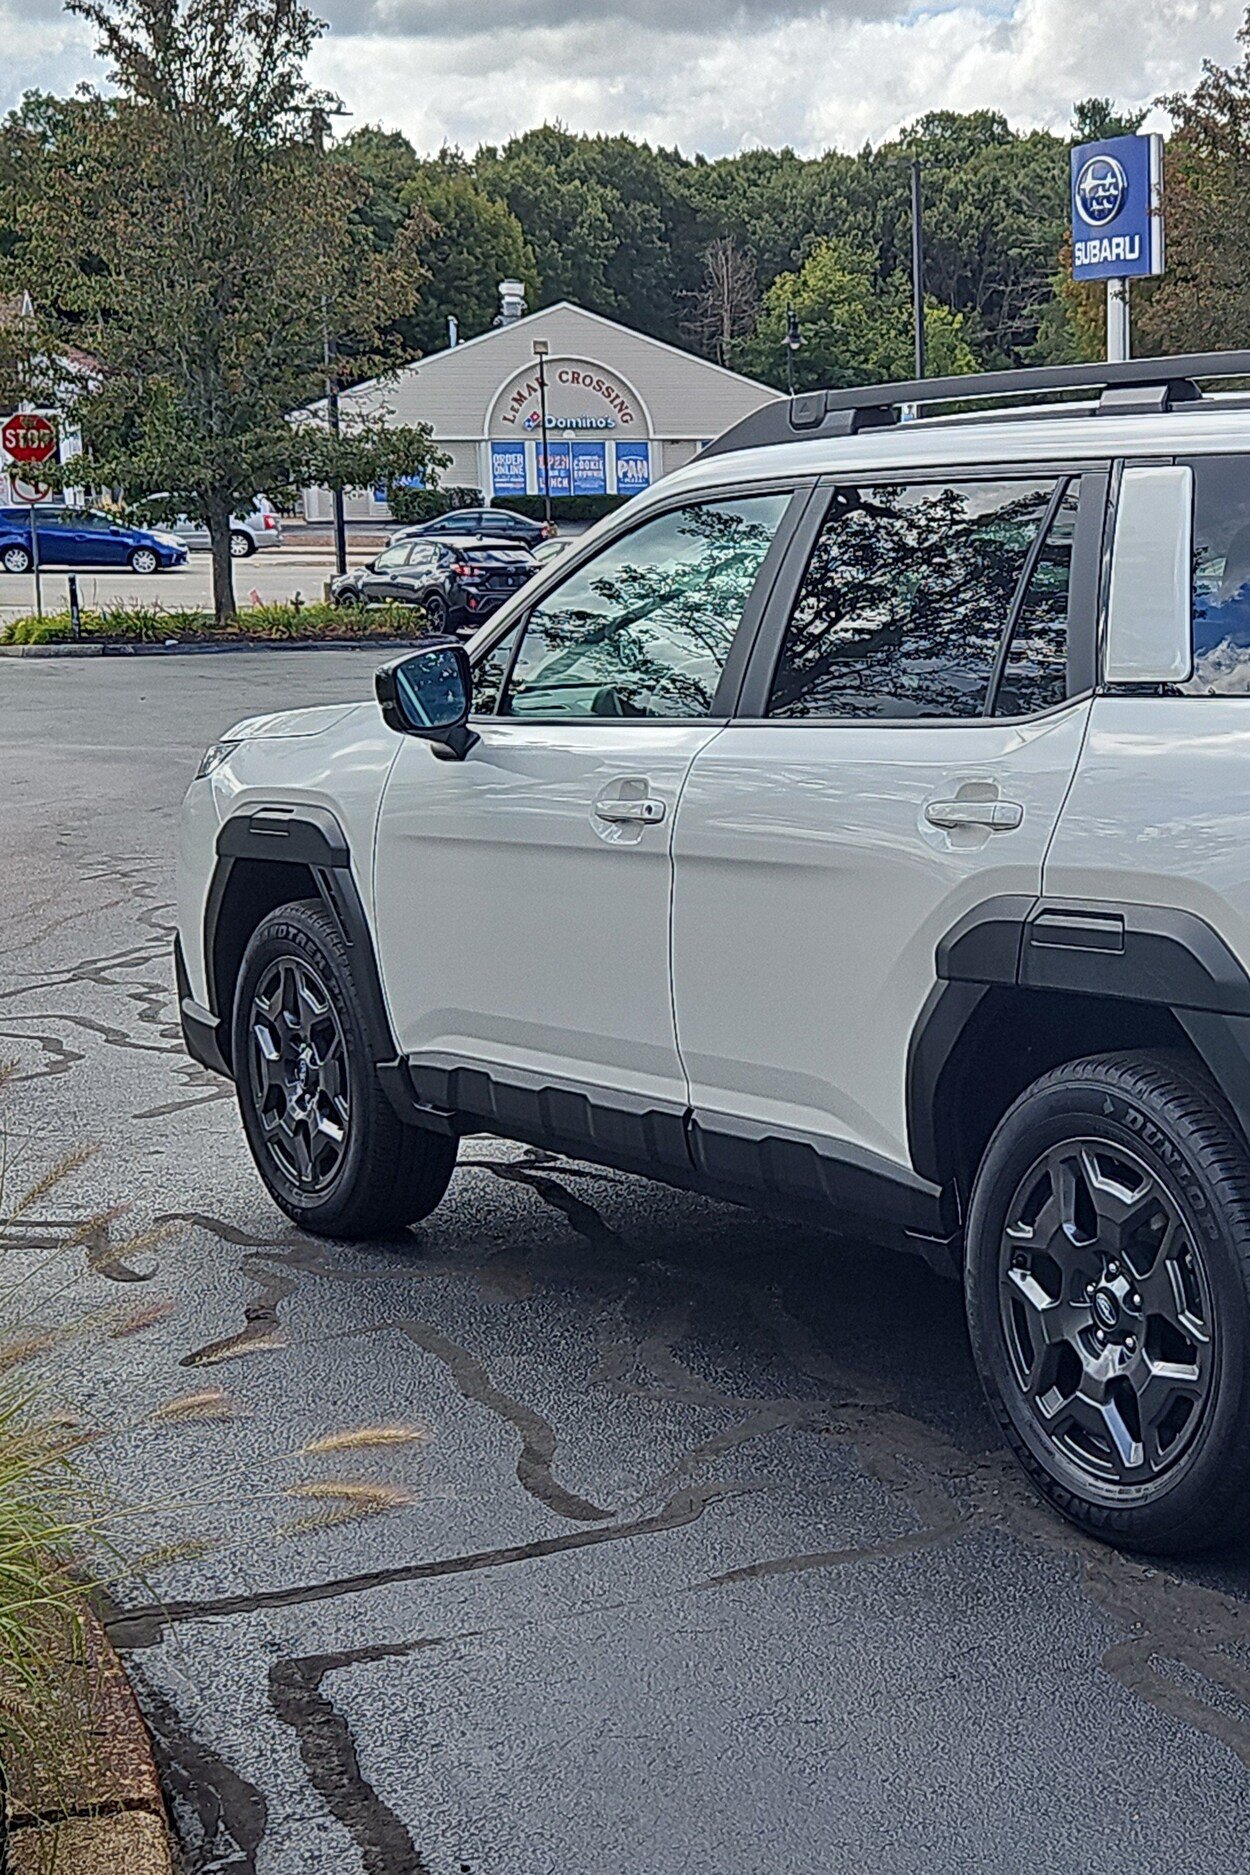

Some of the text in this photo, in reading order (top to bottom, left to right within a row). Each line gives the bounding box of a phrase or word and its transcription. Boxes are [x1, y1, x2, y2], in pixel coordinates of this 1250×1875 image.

[1075, 234, 1140, 267] SUBARU
[557, 370, 635, 425] CROSSING
[545, 414, 616, 429] Domino's
[5, 429, 51, 449] STOP
[493, 453, 524, 465] ORDER
[494, 464, 525, 475] ONLINE
[617, 460, 648, 479] PAN
[539, 477, 569, 488] LNCH
[1124, 1107, 1219, 1240] DUNLOP
